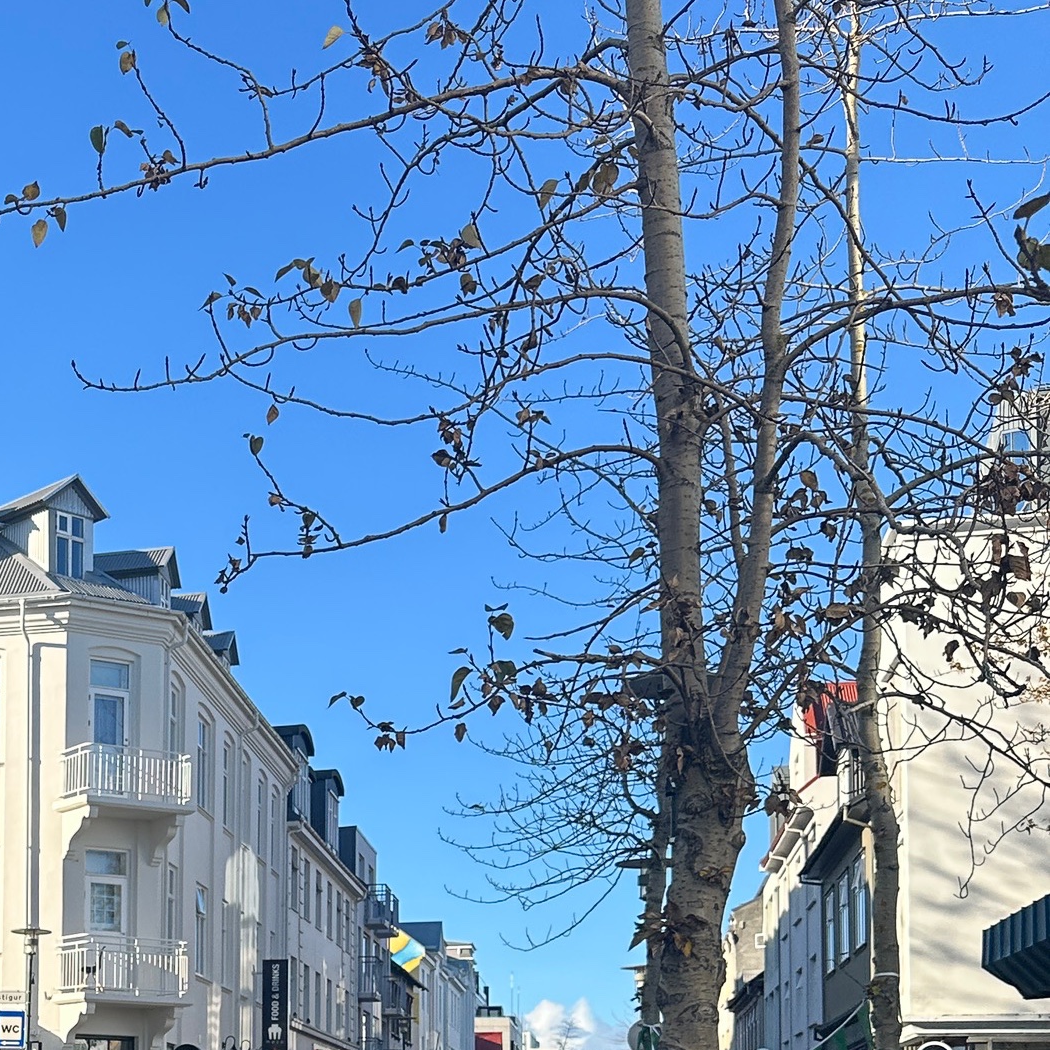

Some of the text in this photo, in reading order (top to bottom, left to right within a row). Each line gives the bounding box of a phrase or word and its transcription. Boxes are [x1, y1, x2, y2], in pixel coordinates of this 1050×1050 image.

[271, 963, 280, 992] DRINKS
[271, 1000, 280, 1021] FOOD
[1, 1024, 20, 1034] WC
